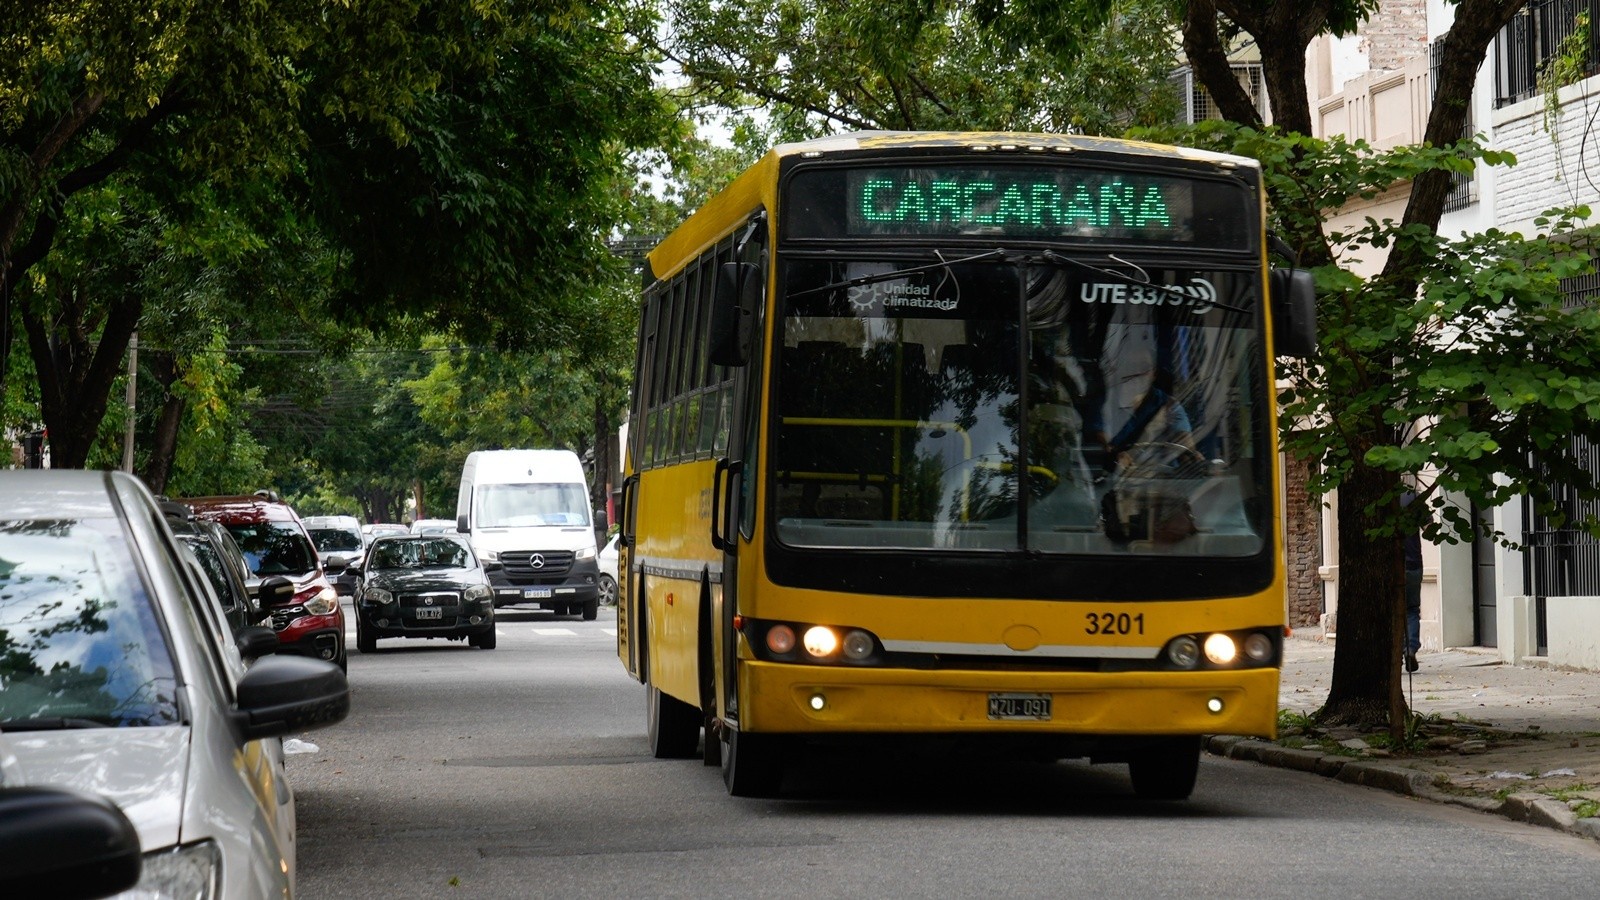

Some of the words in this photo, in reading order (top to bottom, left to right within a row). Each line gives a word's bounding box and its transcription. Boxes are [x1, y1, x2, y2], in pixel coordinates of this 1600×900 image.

[863, 179, 1170, 227] CARCARAÑA
[883, 283, 930, 295] Unidad
[882, 295, 957, 309] climatizada
[1085, 613, 1144, 635] 3201
